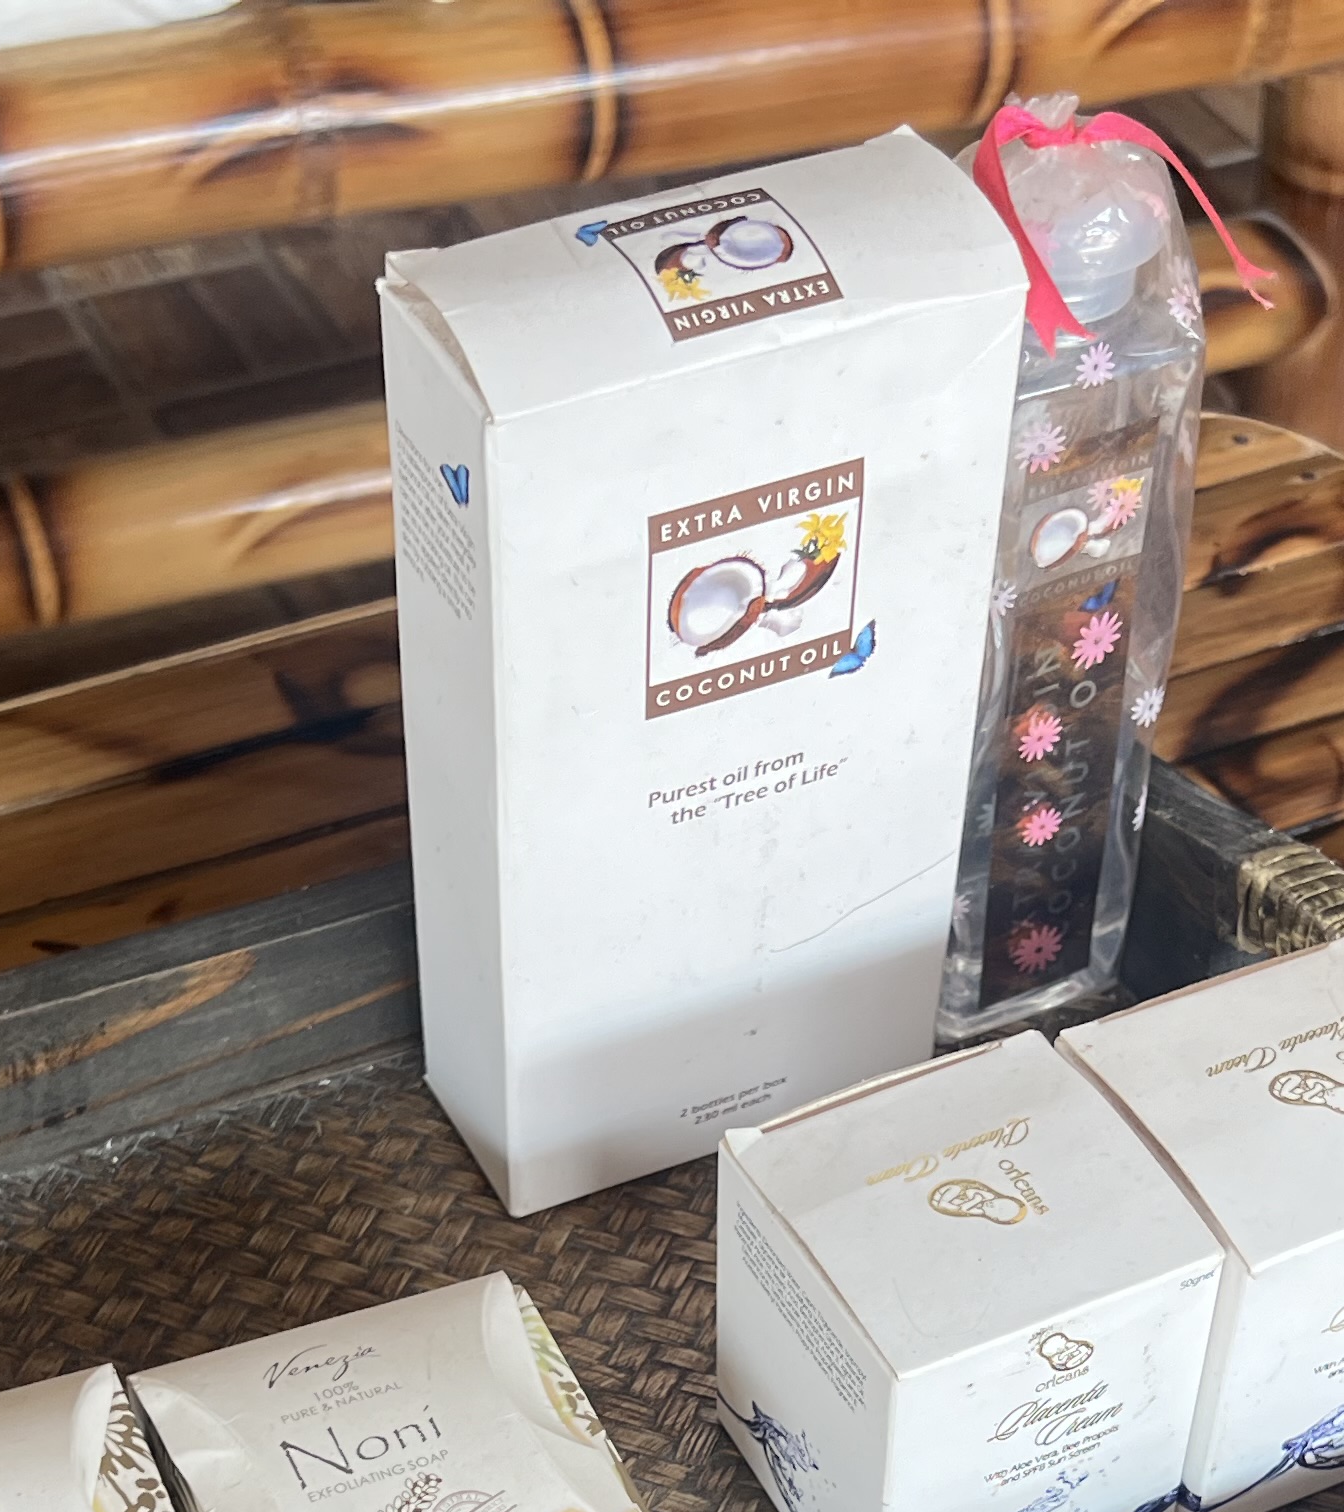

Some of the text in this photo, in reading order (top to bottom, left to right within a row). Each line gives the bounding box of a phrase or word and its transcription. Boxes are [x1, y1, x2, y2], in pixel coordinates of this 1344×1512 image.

[607, 192, 761, 237] COCONUT OIL
[673, 280, 830, 331] EXTRA VIRGIN
[661, 472, 854, 542] EXTRA VIRGIN
[656, 640, 842, 707] COCONUT OIL
[648, 752, 804, 808] Purest oil from
[671, 805, 706, 825] the
[774, 774, 797, 793] of
[1205, 1047, 1276, 1077] Cream
[680, 1076, 787, 1118] 2 bottles per box
[741, 1094, 771, 1109] each
[865, 1117, 1031, 1186] Placenta Cream
[998, 1159, 1050, 1215] orleans
[262, 1344, 381, 1389] Venezia
[1035, 1365, 1089, 1394] orleans
[280, 1381, 403, 1426] PURE & NATURAL
[313, 1380, 360, 1402] 100%
[987, 1380, 1108, 1443] Placenta
[1035, 1402, 1123, 1446] Cream
[279, 1404, 442, 1490] Noni
[1000, 1474, 1020, 1486] and
[1047, 1456, 1066, 1468] Sun
[1068, 1442, 1101, 1460] Screen
[1010, 1460, 1033, 1474] Aloe
[1062, 1441, 1080, 1454] Bee
[307, 1448, 450, 1503] EXFOLIATING SOAP
